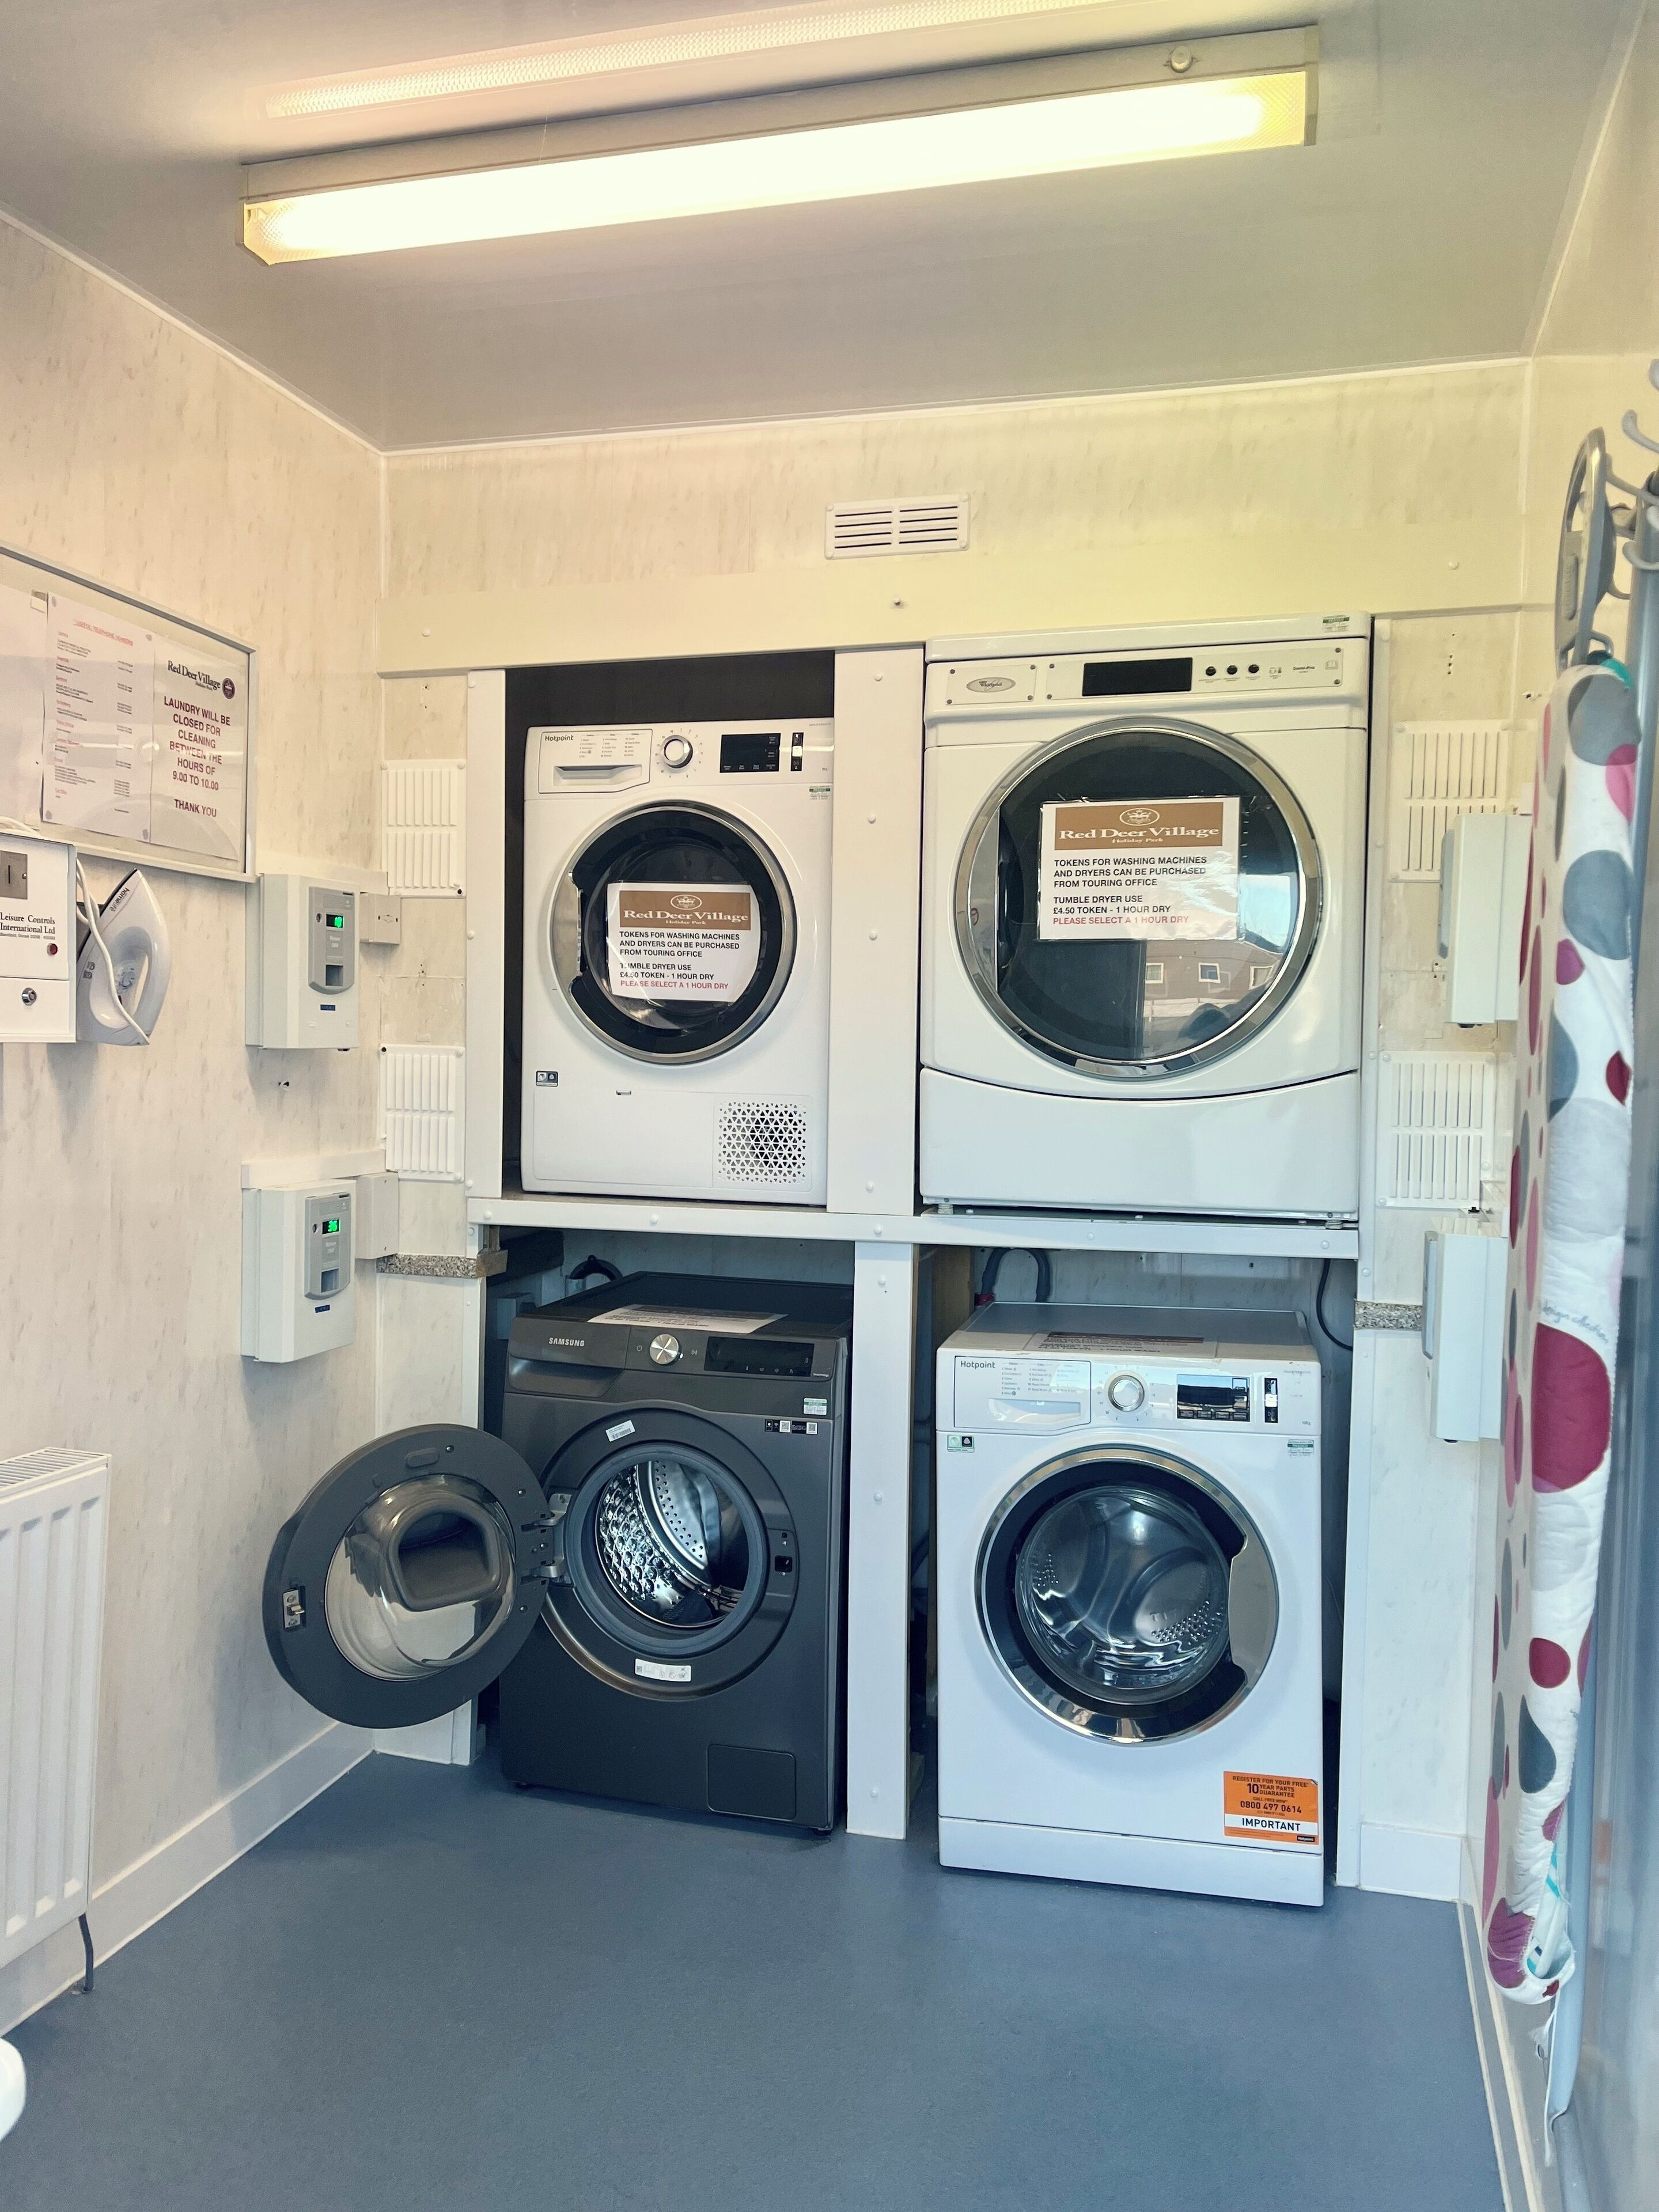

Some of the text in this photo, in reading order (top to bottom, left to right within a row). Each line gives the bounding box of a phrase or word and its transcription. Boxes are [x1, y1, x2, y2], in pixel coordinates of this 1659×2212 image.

[168, 660, 221, 690] Red Deer Village
[164, 696, 230, 726] LAUNDRY WILL BE
[173, 714, 221, 736] CLOSED FOR
[178, 729, 215, 748] CLEANING
[170, 741, 222, 764] BETWEEN THE
[177, 757, 215, 775] HOURS OF
[173, 771, 219, 790] 9.00 TO 10.00
[174, 799, 217, 817] THANK YOU
[1059, 827, 1219, 839] Red Deer Village
[1055, 859, 1090, 867] TOKENS
[1158, 857, 1207, 865] MACHINES
[1075, 869, 1111, 877] DRYERS
[0, 912, 55, 924] Leisure Controls
[623, 910, 748, 923] Red Deer Village
[0, 922, 42, 933] International
[549, 1338, 585, 1347] SAMSUNG
[961, 1361, 995, 1369] Hotpoint
[1247, 1783, 1259, 1794] 10
[1260, 1790, 1295, 1798] GUARANTEE
[1240, 1801, 1261, 1809] 0800
[1281, 1805, 1302, 1813] 0614
[1243, 1818, 1301, 1831] IMPORTANT
